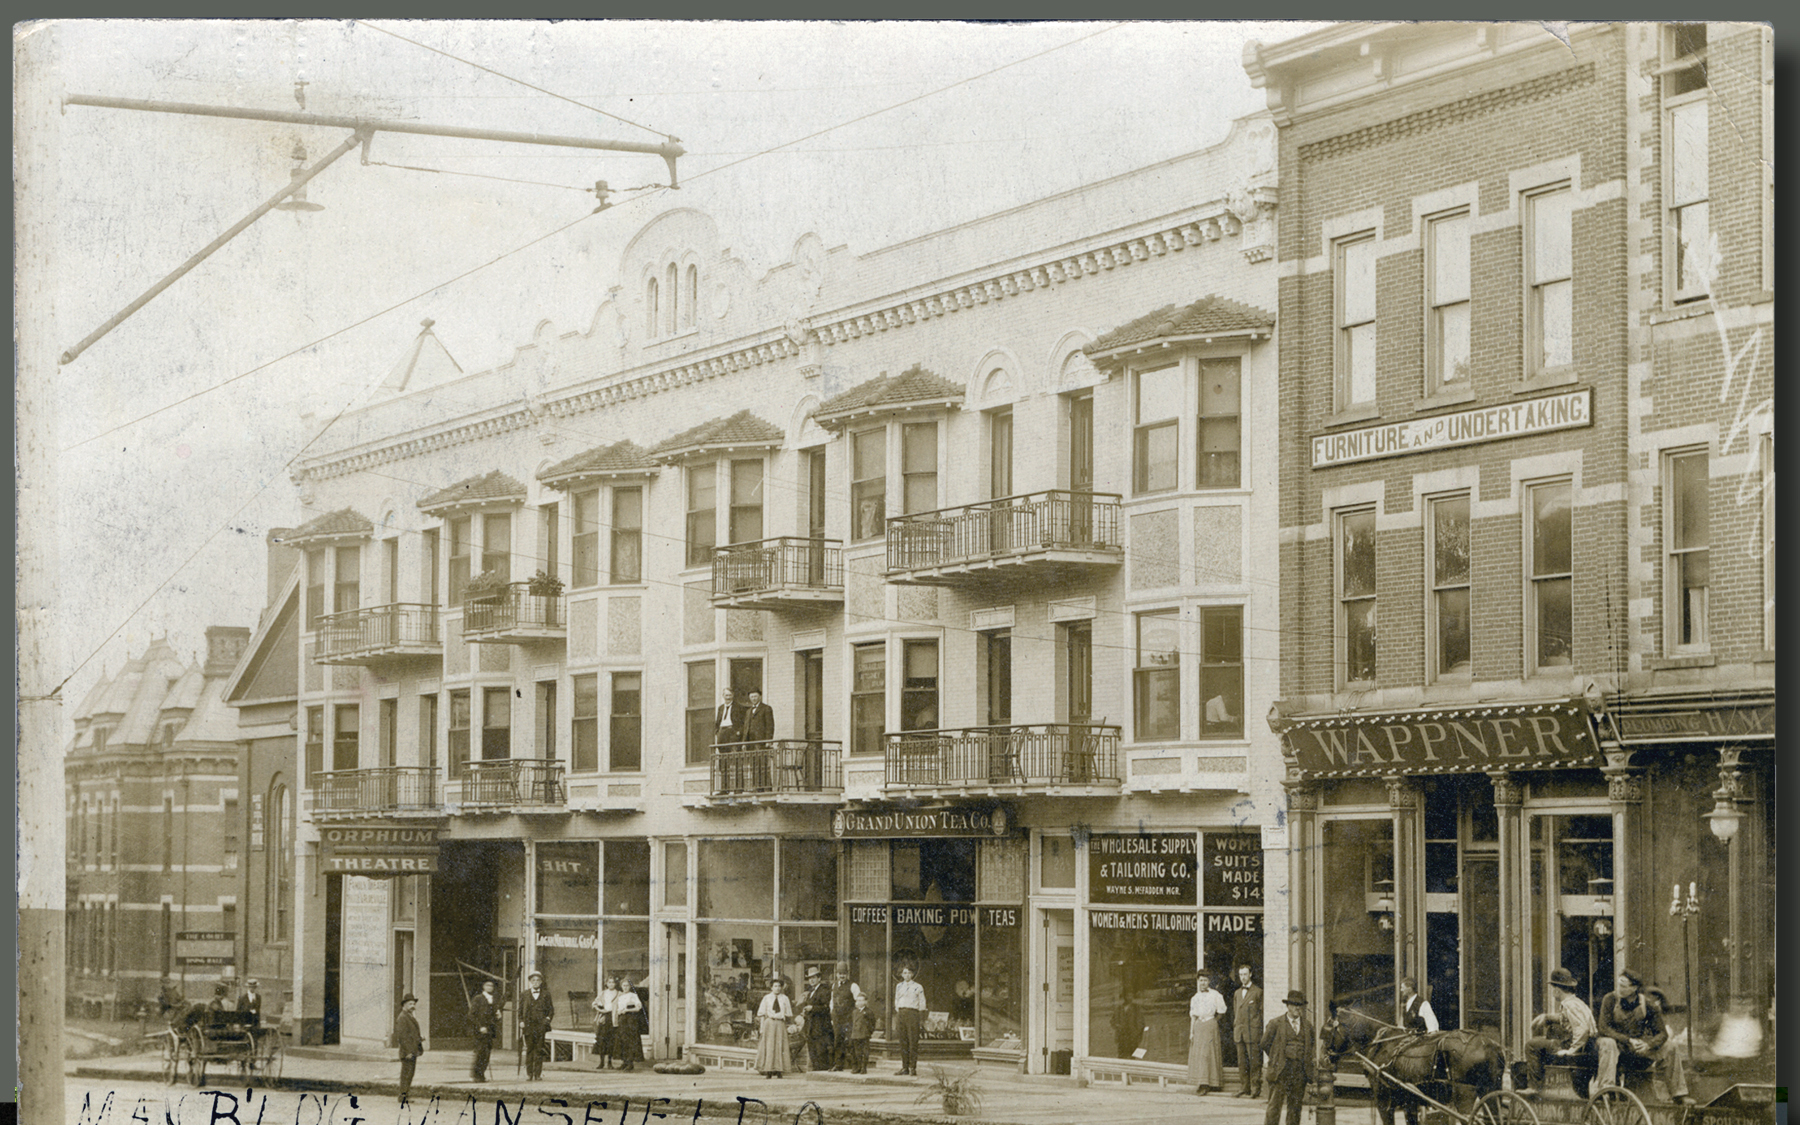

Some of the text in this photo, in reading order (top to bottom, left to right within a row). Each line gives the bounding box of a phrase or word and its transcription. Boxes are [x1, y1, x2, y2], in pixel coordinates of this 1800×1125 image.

[1314, 425, 1409, 464] FURNITURE
[1413, 420, 1444, 447] AND
[1622, 716, 1701, 733] PLUMBING
[1310, 716, 1570, 765] WAPPNER
[845, 813, 893, 831] GRAND
[894, 812, 938, 830] UNION
[940, 811, 968, 830] TEA
[327, 830, 433, 842] ORPHIUM
[1101, 838, 1157, 854] WHOLESALE
[1160, 838, 1198, 854] SUPPLY
[330, 858, 430, 870] THEATRE
[1213, 855, 1261, 867] SUITS
[1100, 862, 1191, 878] & TAILORING CO.
[1222, 870, 1260, 884] MADE
[1106, 885, 1127, 895] WAYNE
[852, 907, 887, 923] COFFEES
[897, 908, 943, 924] BAKING
[989, 909, 1016, 926] TEAS
[1151, 913, 1198, 931] TAILORING
[1208, 915, 1256, 932] MADE
